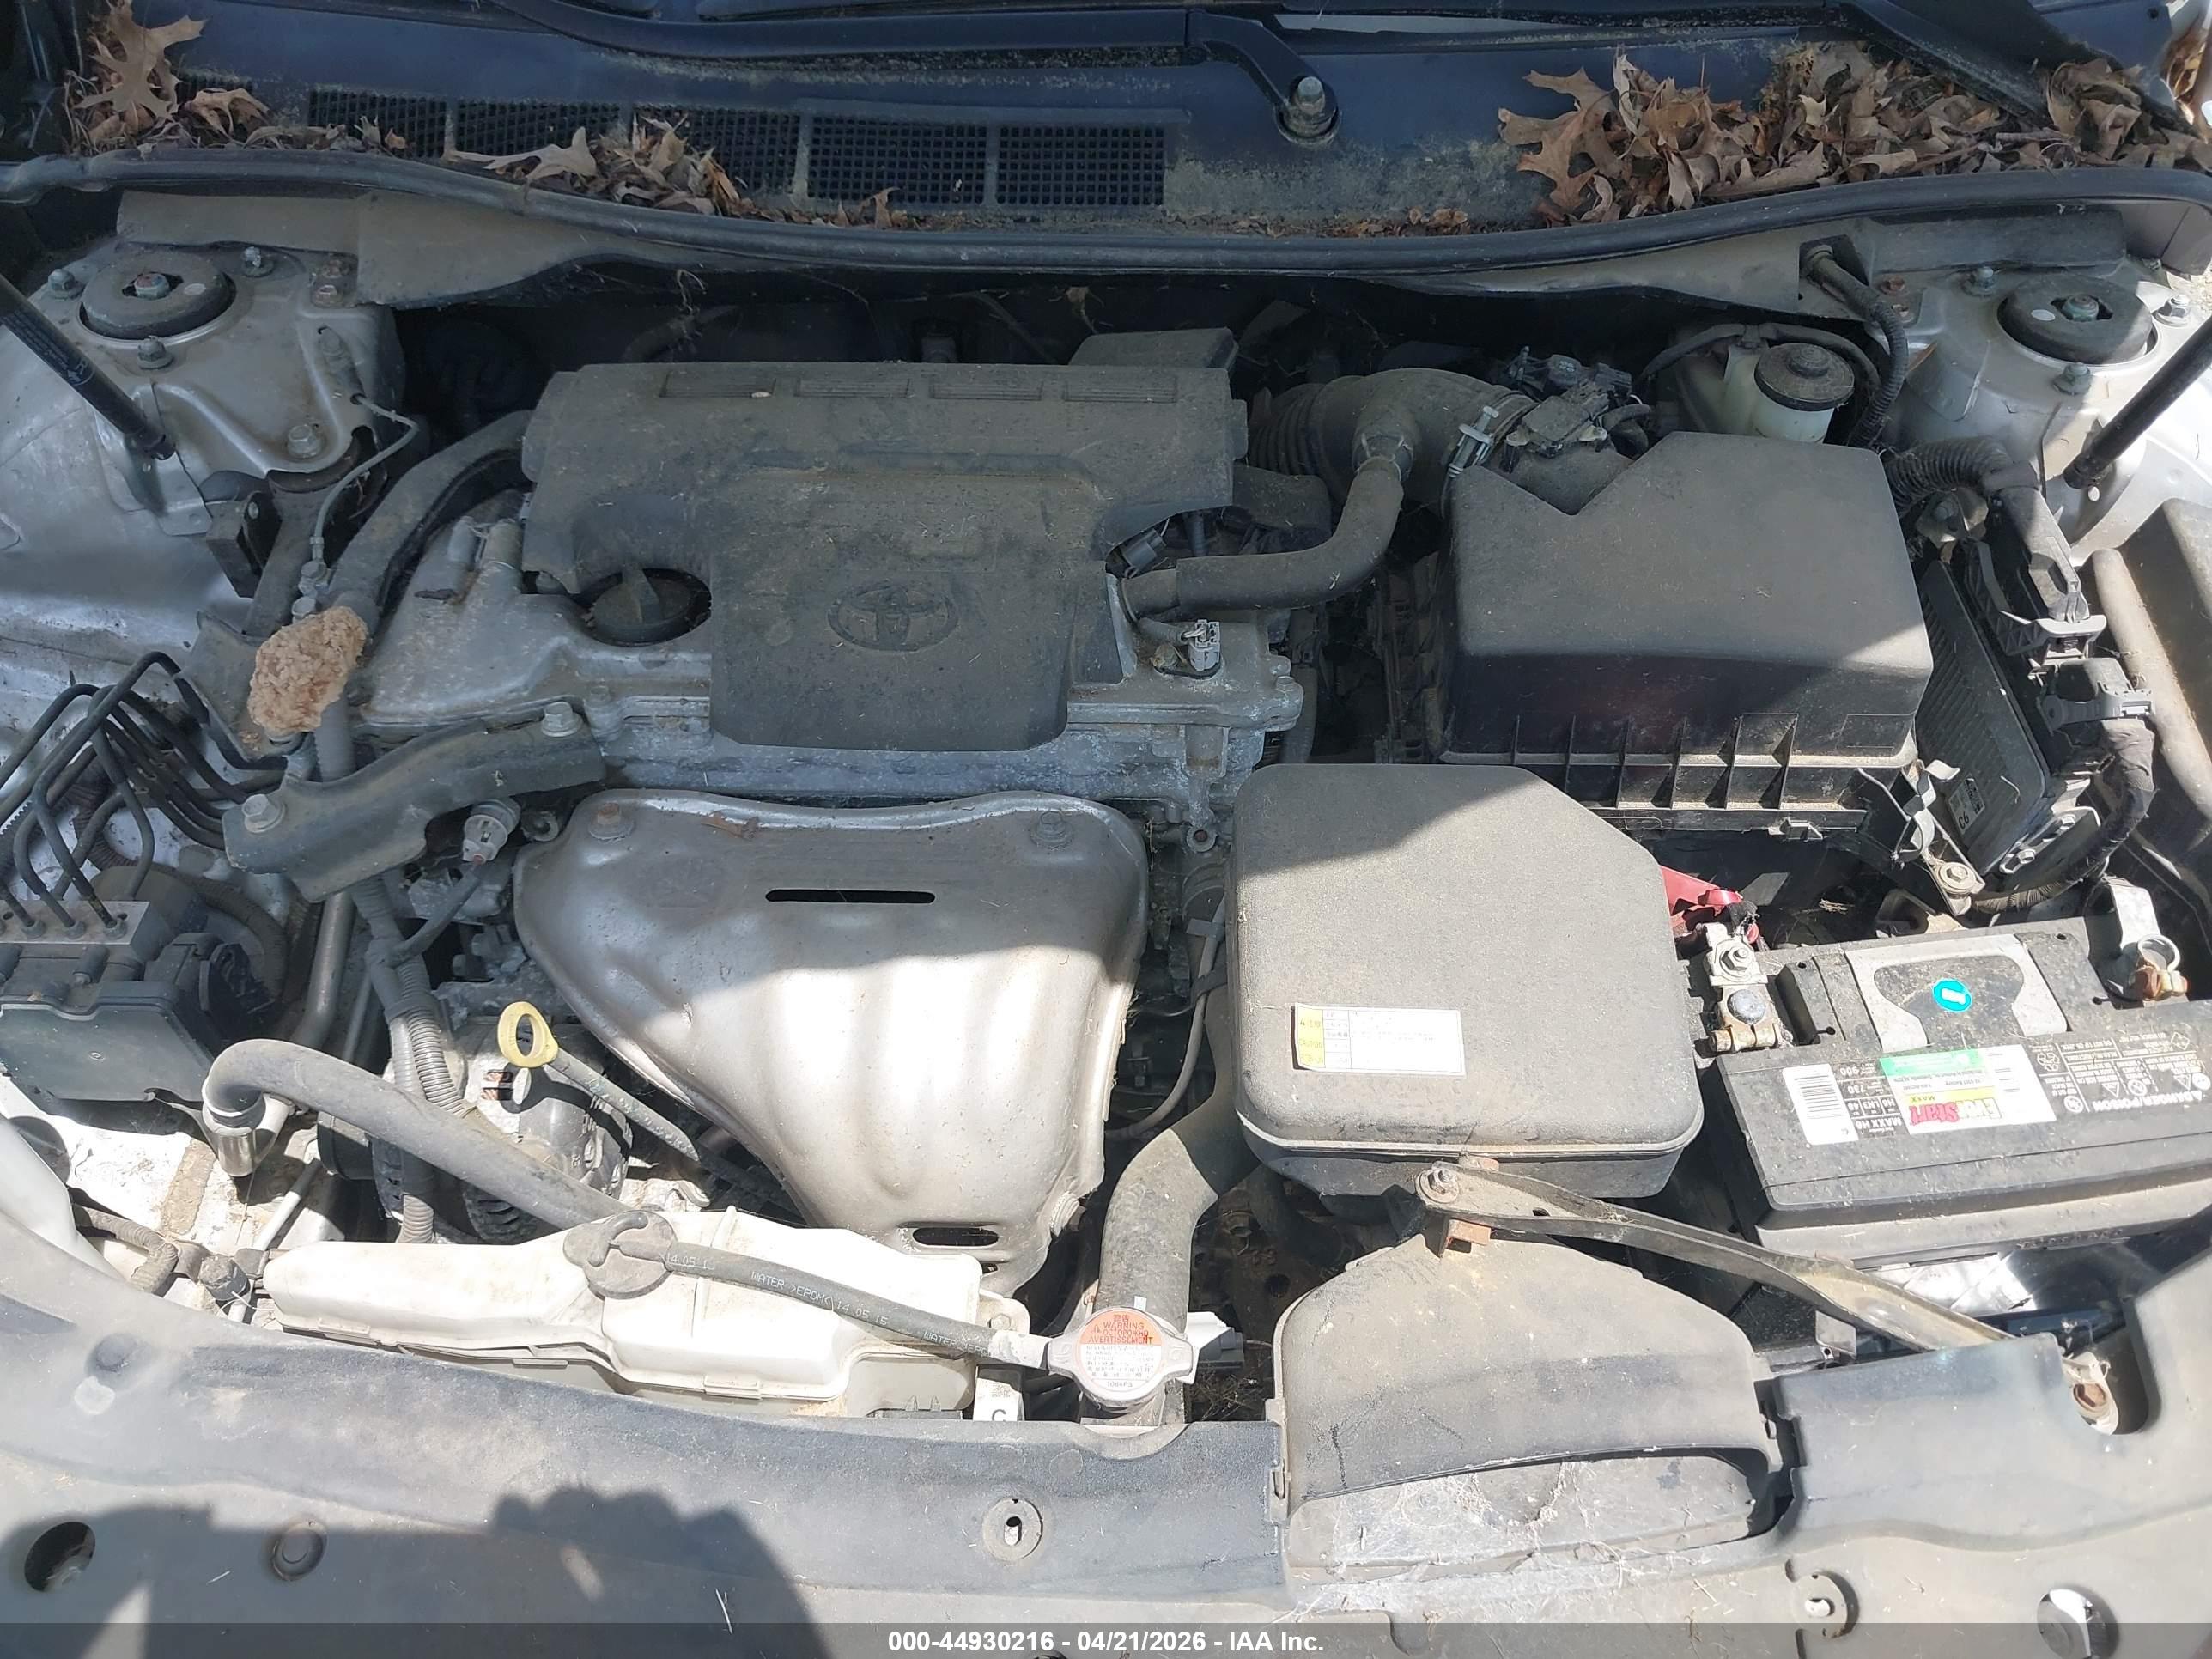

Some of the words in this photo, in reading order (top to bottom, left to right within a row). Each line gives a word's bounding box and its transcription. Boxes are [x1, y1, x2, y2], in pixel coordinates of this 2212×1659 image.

[1840, 1066, 1859, 1076] 900
[1848, 1085, 1866, 1095] 730
[1870, 1117, 1902, 1129] MAXX
[750, 1271, 786, 1290] WATER
[923, 1330, 957, 1347] WATER
[1089, 1336, 1154, 1345] AVERTISSEMENT
